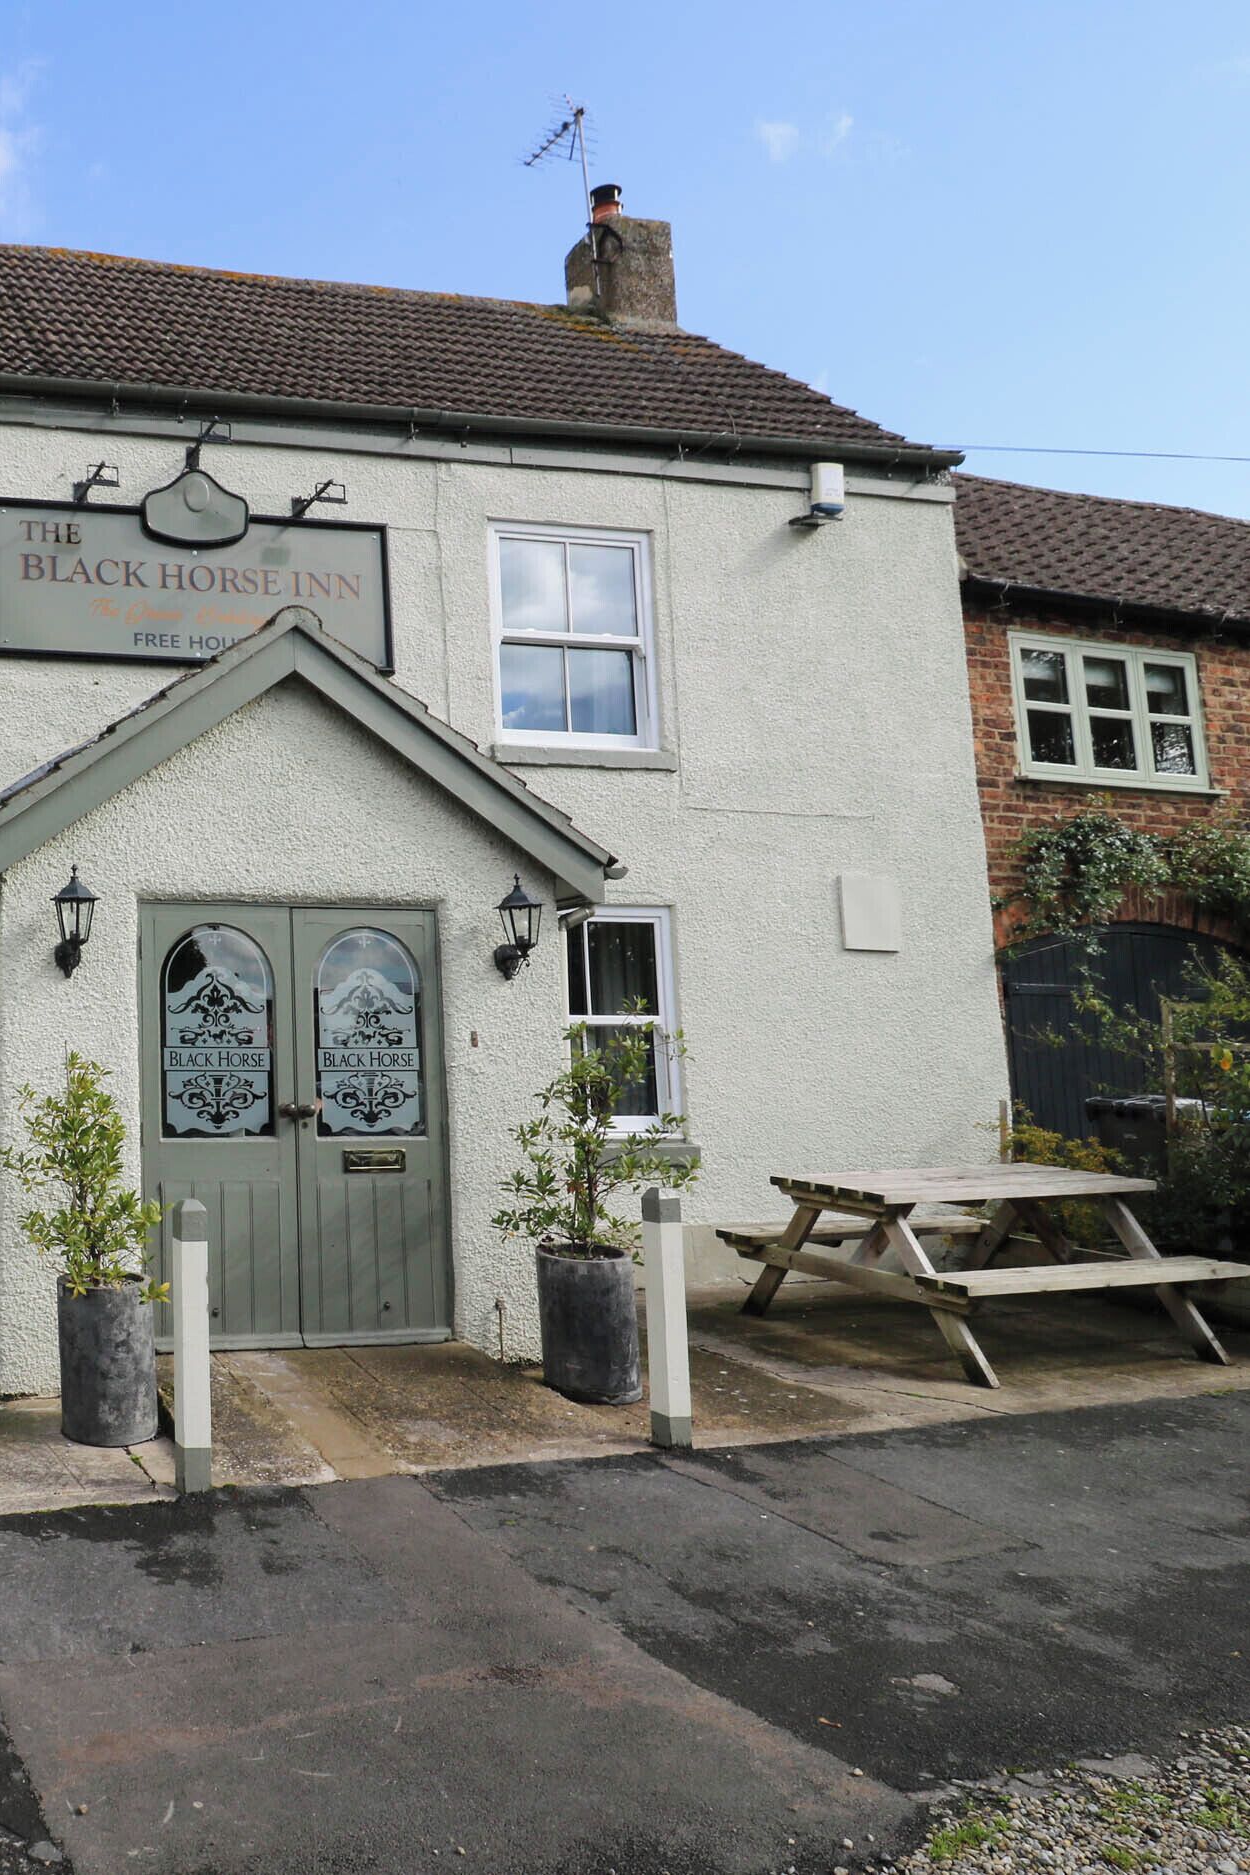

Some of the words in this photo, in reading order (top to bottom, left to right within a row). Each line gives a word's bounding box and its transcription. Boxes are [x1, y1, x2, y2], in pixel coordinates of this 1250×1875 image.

[19, 519, 82, 545] THE
[20, 553, 149, 588] BLACK
[158, 563, 283, 597] HORSE
[291, 571, 362, 601] INN
[134, 632, 181, 649] FREE
[169, 1051, 215, 1067] BLACK
[218, 1051, 265, 1067] HORSE
[323, 1052, 365, 1068] BLACK
[369, 1051, 415, 1067] HORSE
